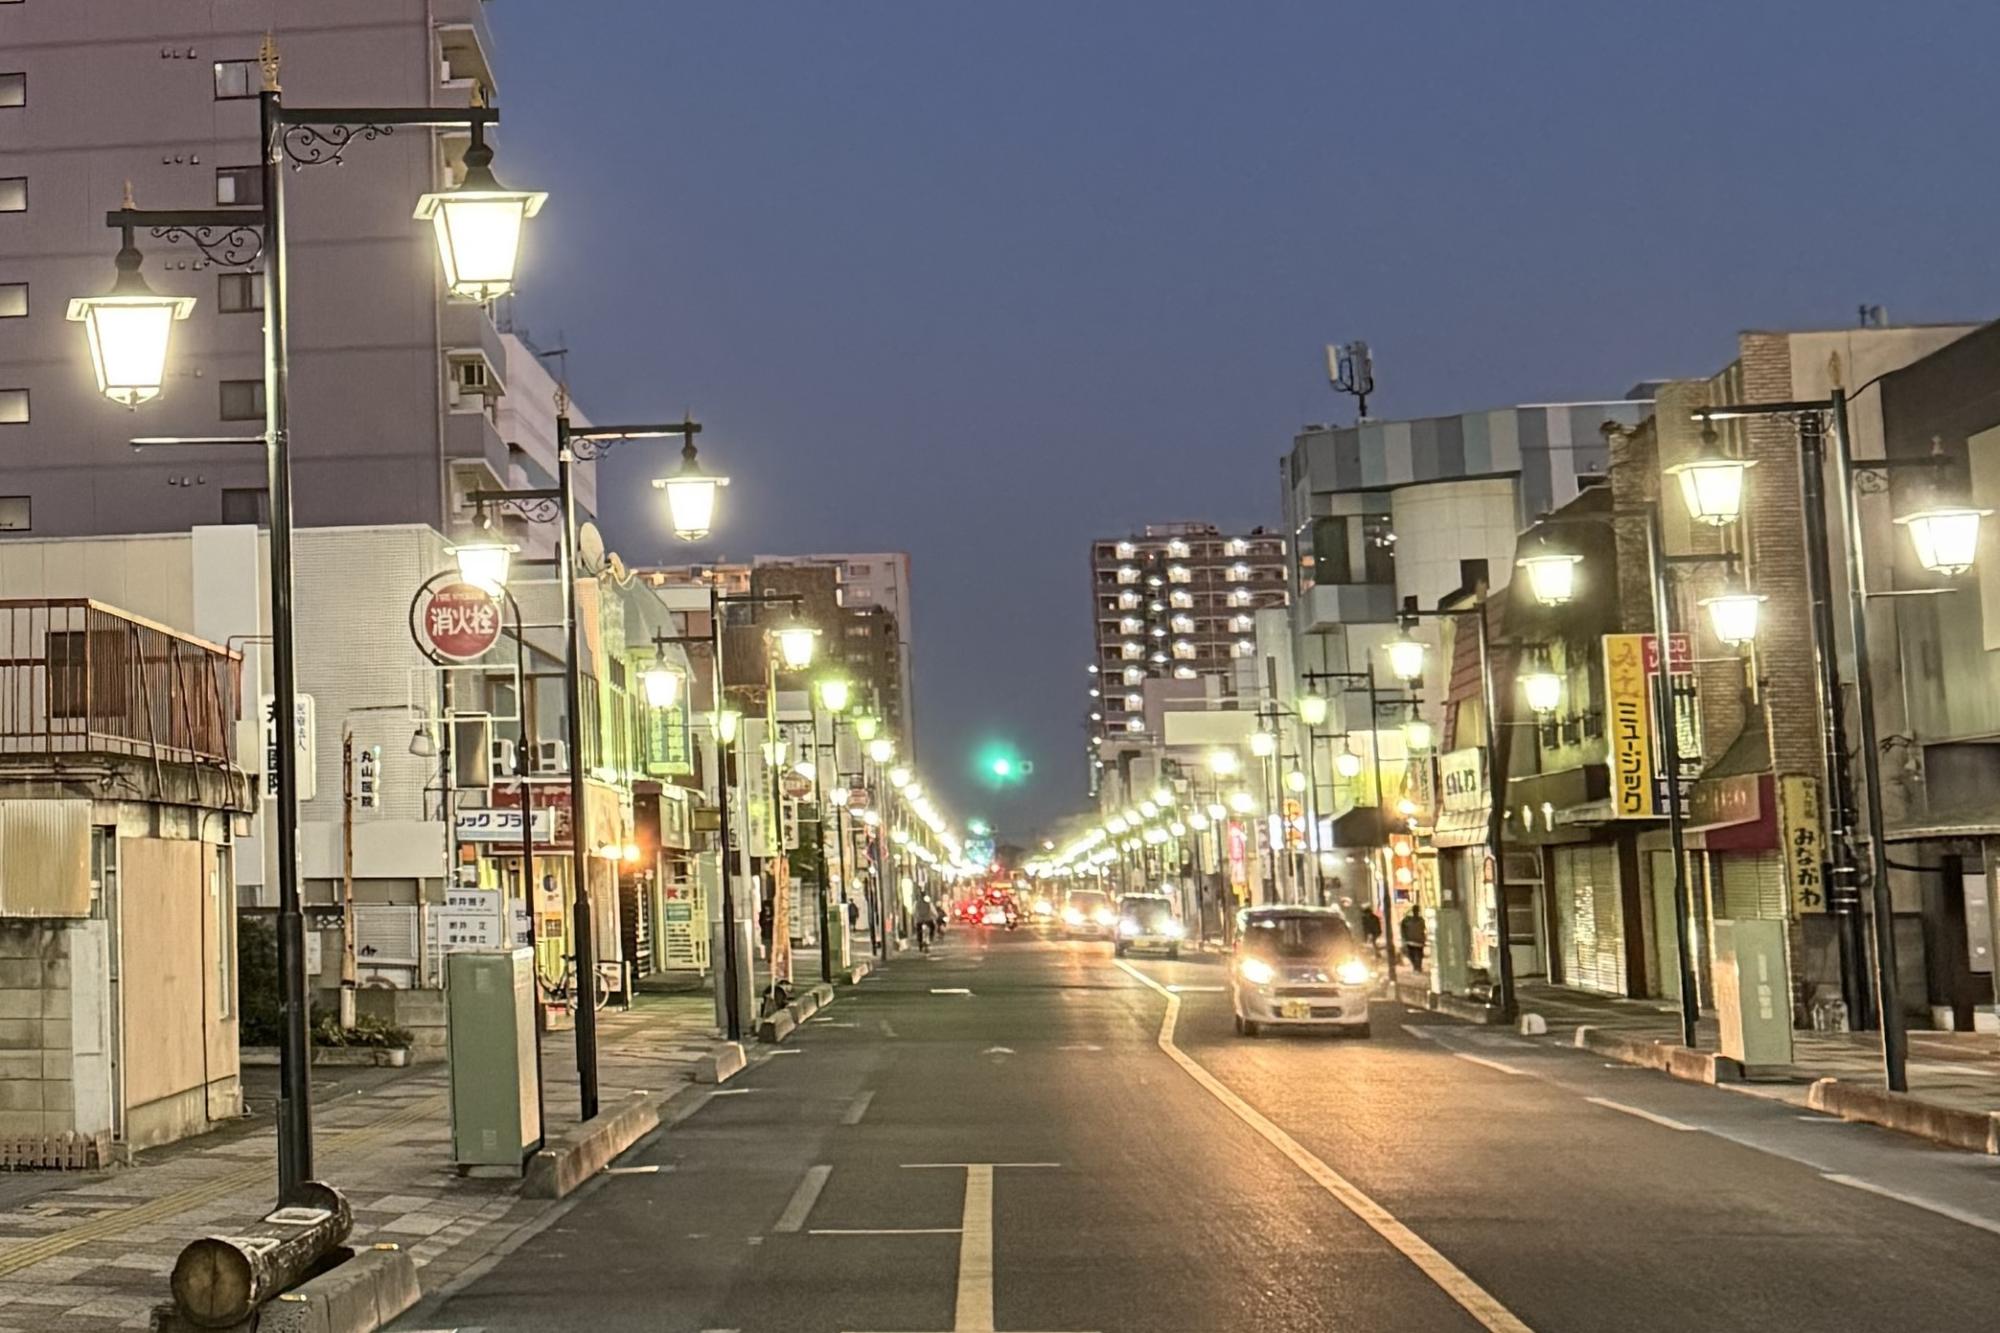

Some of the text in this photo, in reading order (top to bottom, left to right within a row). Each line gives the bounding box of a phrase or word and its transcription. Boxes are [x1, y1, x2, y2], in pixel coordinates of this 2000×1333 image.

[430, 604, 495, 636] 消火栓
[361, 751, 374, 808] 丸山医院
[1617, 702, 1642, 813] ミュージック
